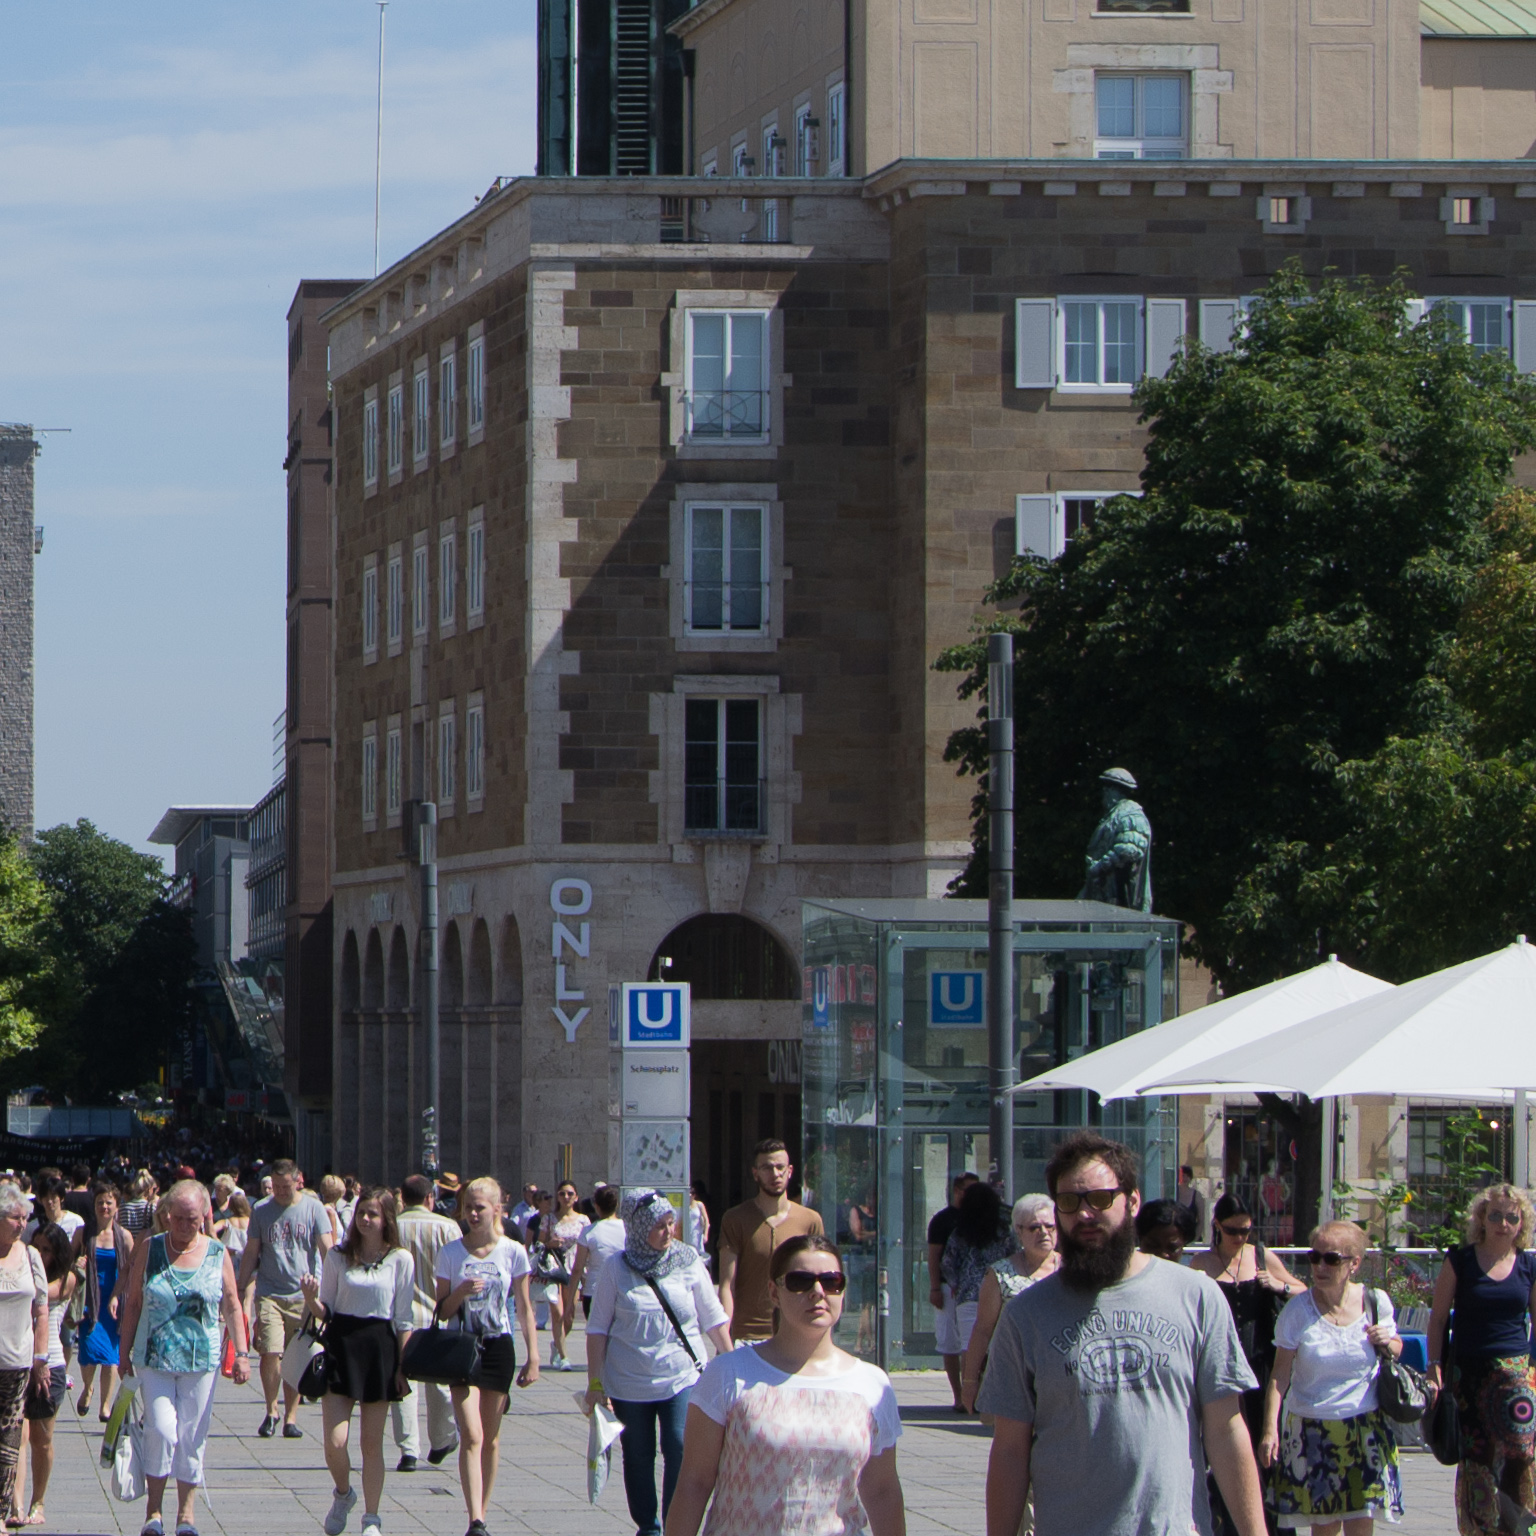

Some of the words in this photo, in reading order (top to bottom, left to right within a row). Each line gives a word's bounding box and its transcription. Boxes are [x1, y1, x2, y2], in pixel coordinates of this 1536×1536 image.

[550, 877, 592, 1042] ONLY
[637, 991, 673, 1029] U
[940, 976, 974, 1011] U
[767, 1039, 803, 1084] ONLY
[1153, 1353, 1170, 1368] 72
